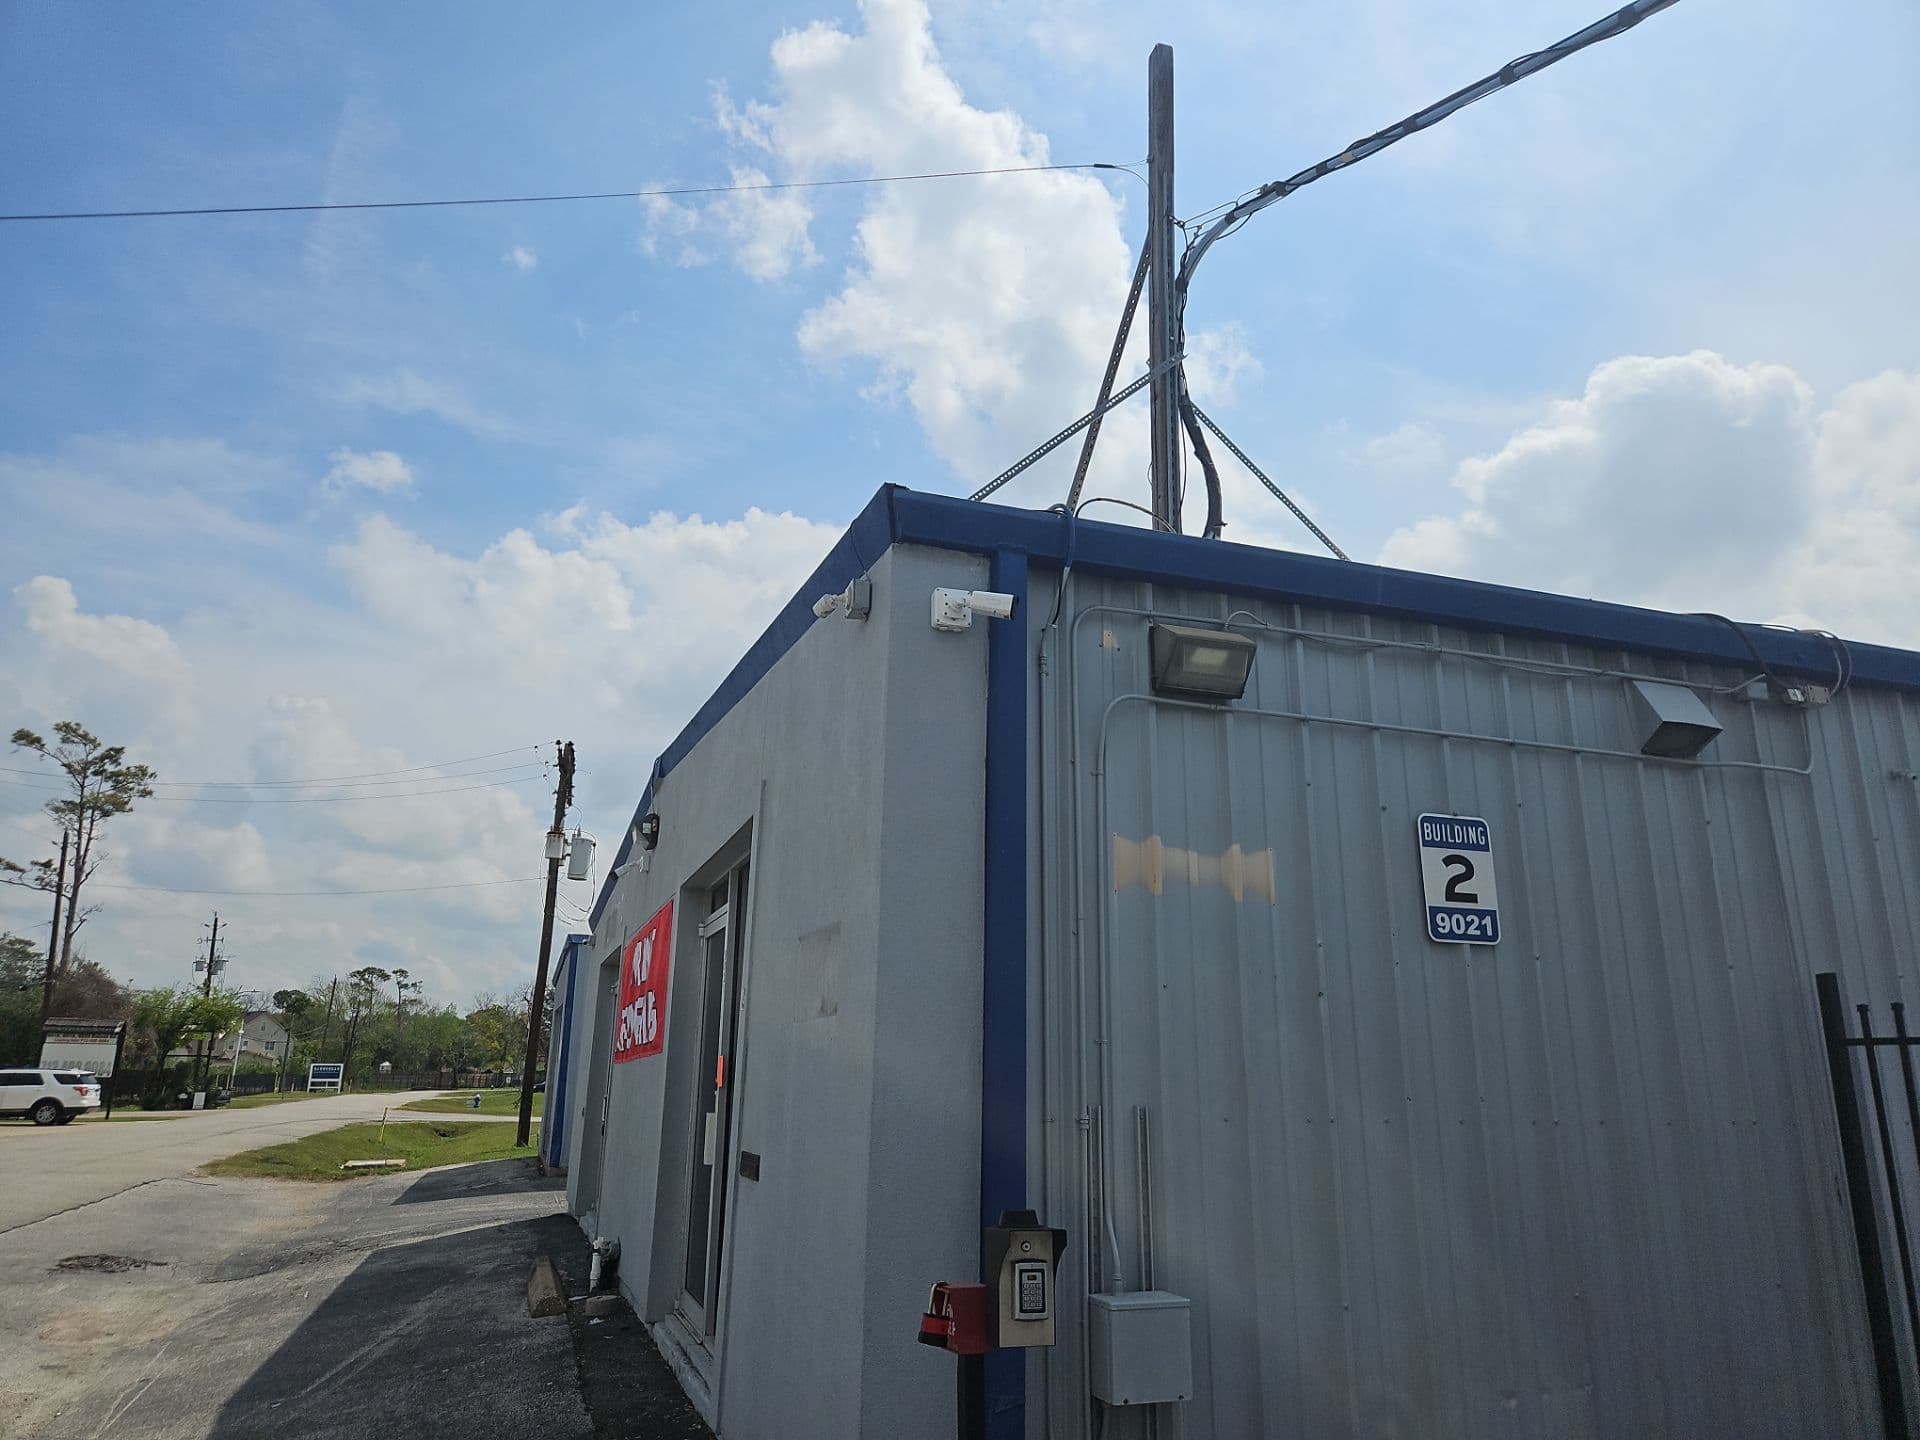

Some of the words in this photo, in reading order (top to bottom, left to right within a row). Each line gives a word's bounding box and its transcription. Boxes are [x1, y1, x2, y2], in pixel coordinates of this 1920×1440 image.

[1423, 822, 1486, 845] BUILDING
[1441, 854, 1479, 904] 2
[1436, 912, 1493, 936] 9021
